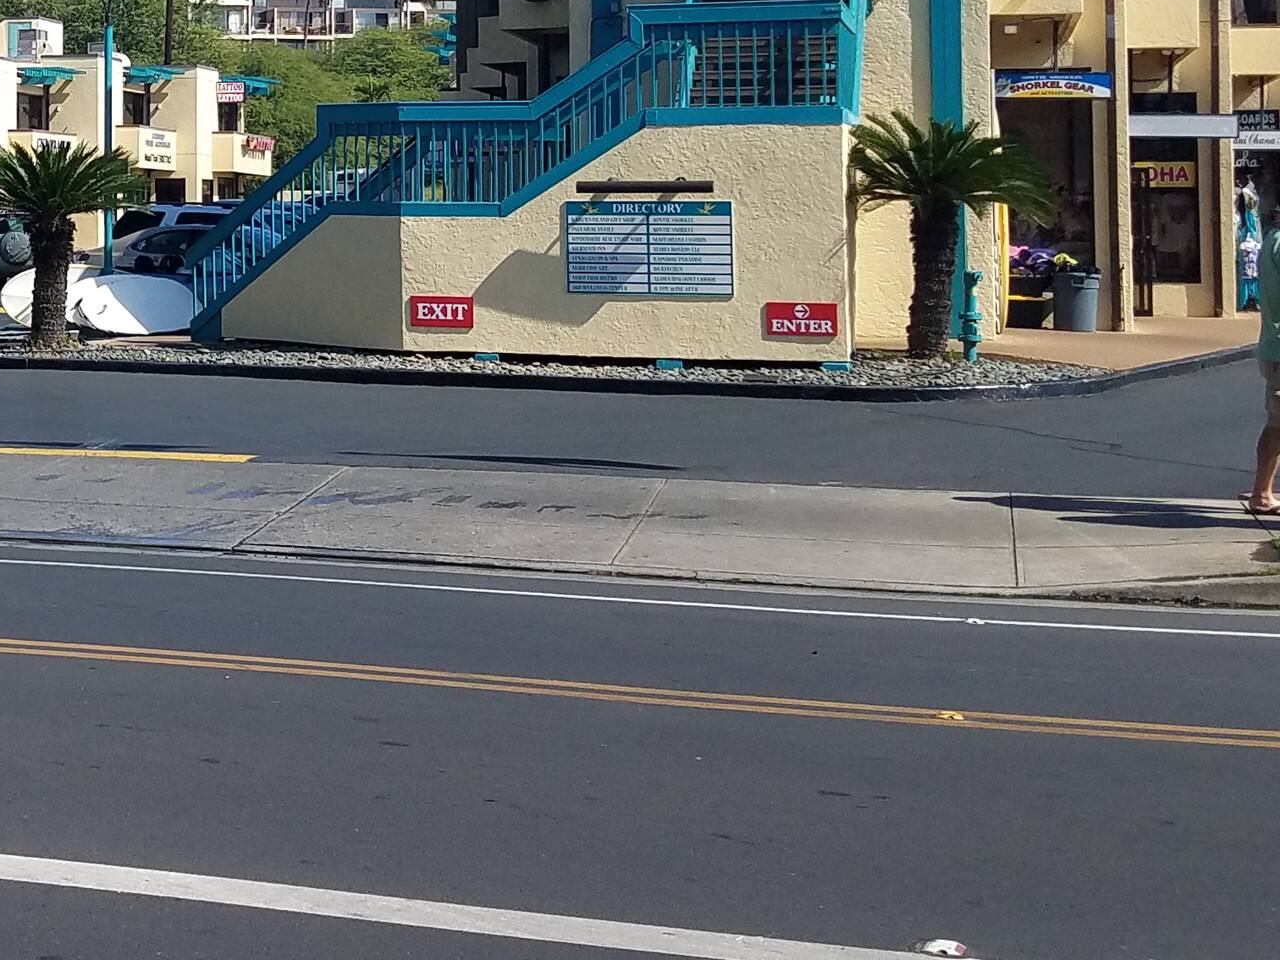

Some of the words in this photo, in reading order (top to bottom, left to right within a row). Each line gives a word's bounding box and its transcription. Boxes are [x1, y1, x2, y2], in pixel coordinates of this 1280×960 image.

[217, 83, 243, 92] TATTOO
[1009, 81, 1063, 94] SNORKEL
[1064, 82, 1094, 94] GEAR
[217, 94, 243, 102] TATTOO
[1147, 166, 1189, 182] OHA
[612, 203, 684, 213] DIRECTORY
[416, 303, 468, 321] EXIT
[771, 319, 834, 333] ENTER
